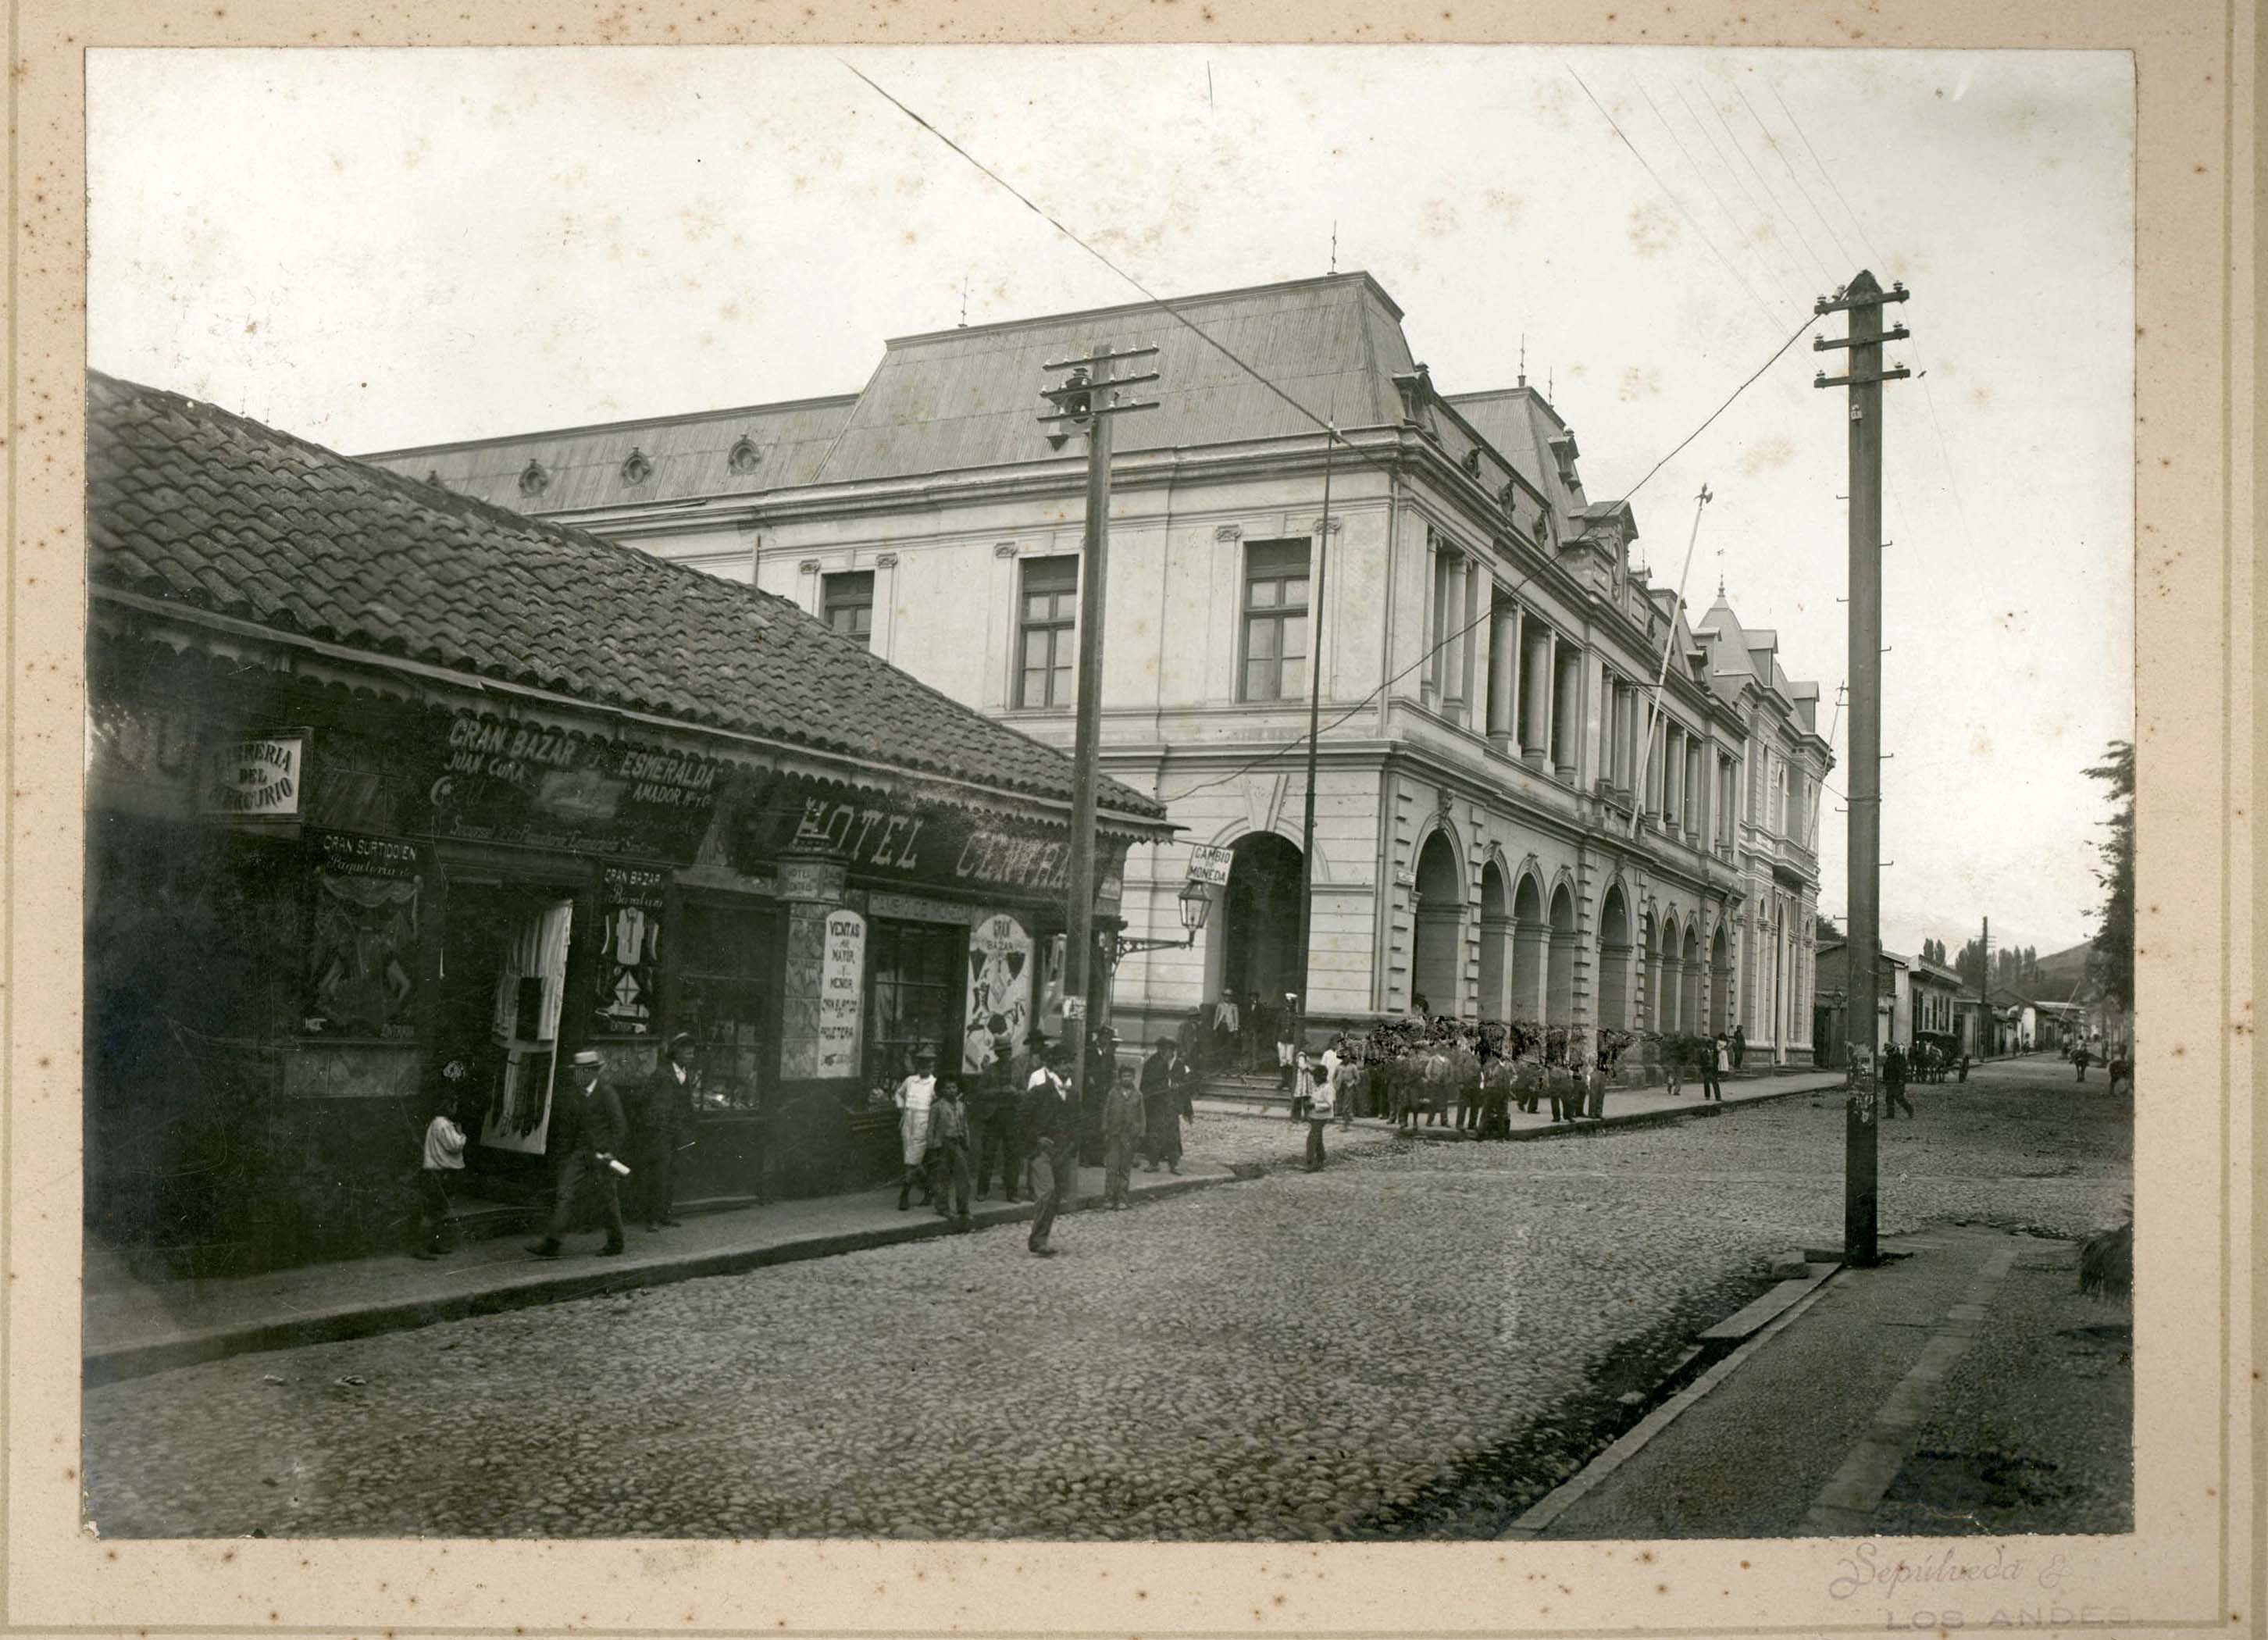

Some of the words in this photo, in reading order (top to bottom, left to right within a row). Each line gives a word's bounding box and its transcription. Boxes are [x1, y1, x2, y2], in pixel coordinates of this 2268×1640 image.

[450, 718, 511, 754] GRAN
[509, 729, 577, 766] BAZAR
[239, 768, 267, 783] DEL
[209, 777, 294, 812] MERCURIO
[791, 797, 923, 871] HOTEL
[323, 835, 353, 854] GRAN
[402, 845, 417, 861] EN
[1195, 847, 1231, 864] CAMBIO
[1189, 865, 1226, 883] MONEDA
[829, 922, 860, 938] VENTAS
[1829, 1542, 2029, 1599] Sepúlveda
[1886, 1610, 1965, 1631] LOS
